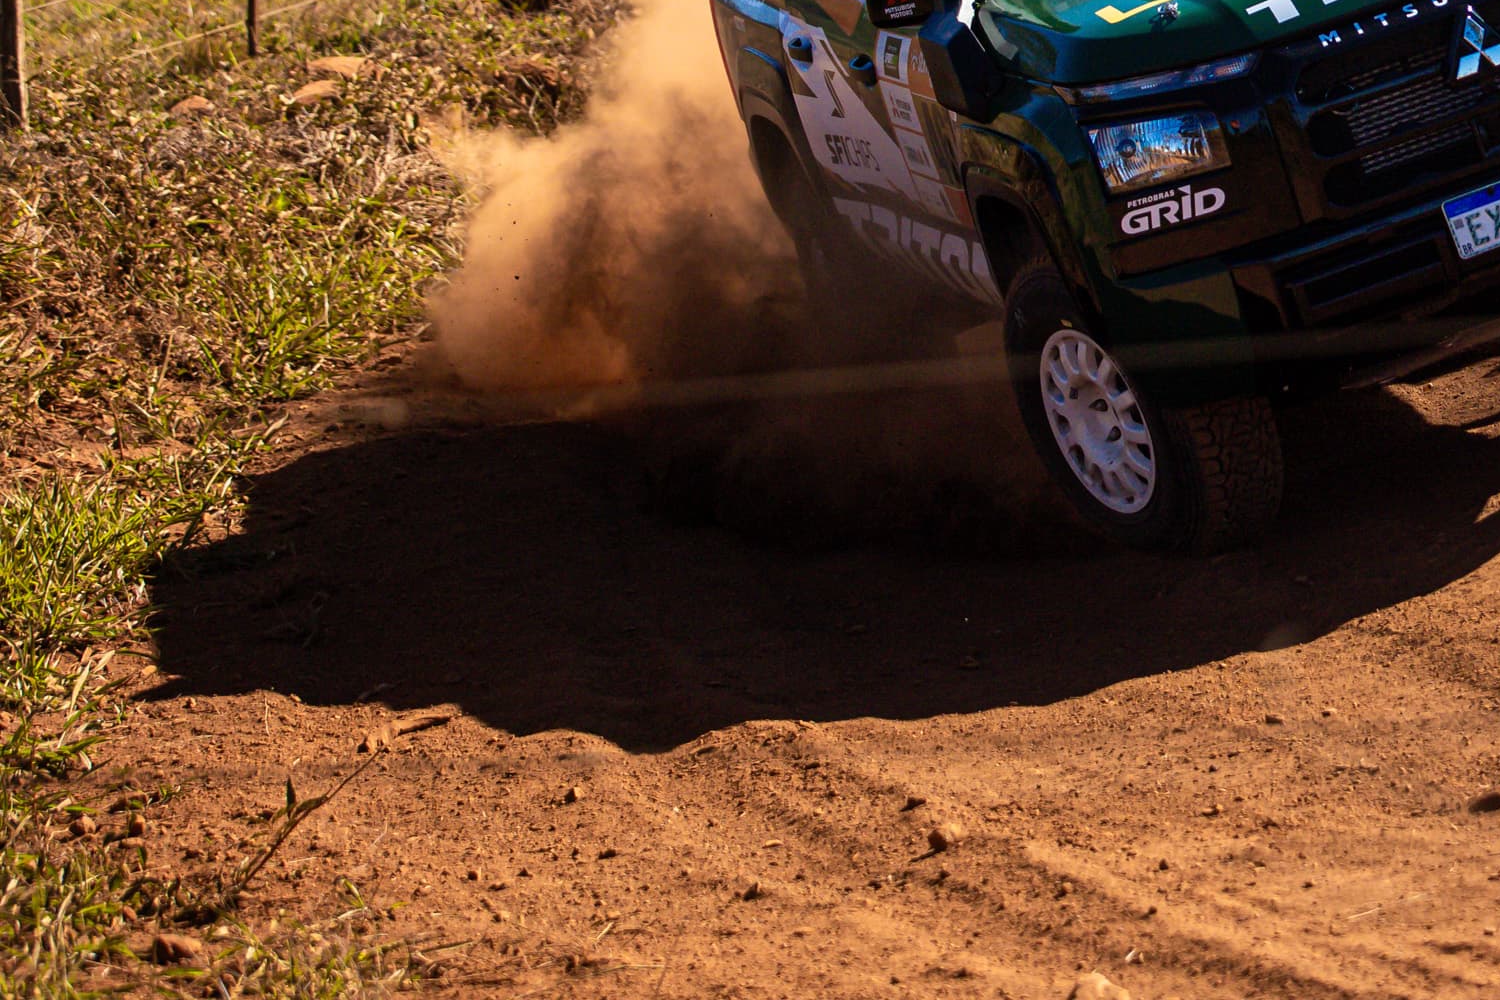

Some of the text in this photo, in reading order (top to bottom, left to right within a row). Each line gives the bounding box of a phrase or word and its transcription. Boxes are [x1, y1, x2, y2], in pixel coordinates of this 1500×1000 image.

[1127, 189, 1175, 208] PETROBRAS
[1121, 184, 1226, 235] GRID
[1462, 243, 1474, 255] BR
